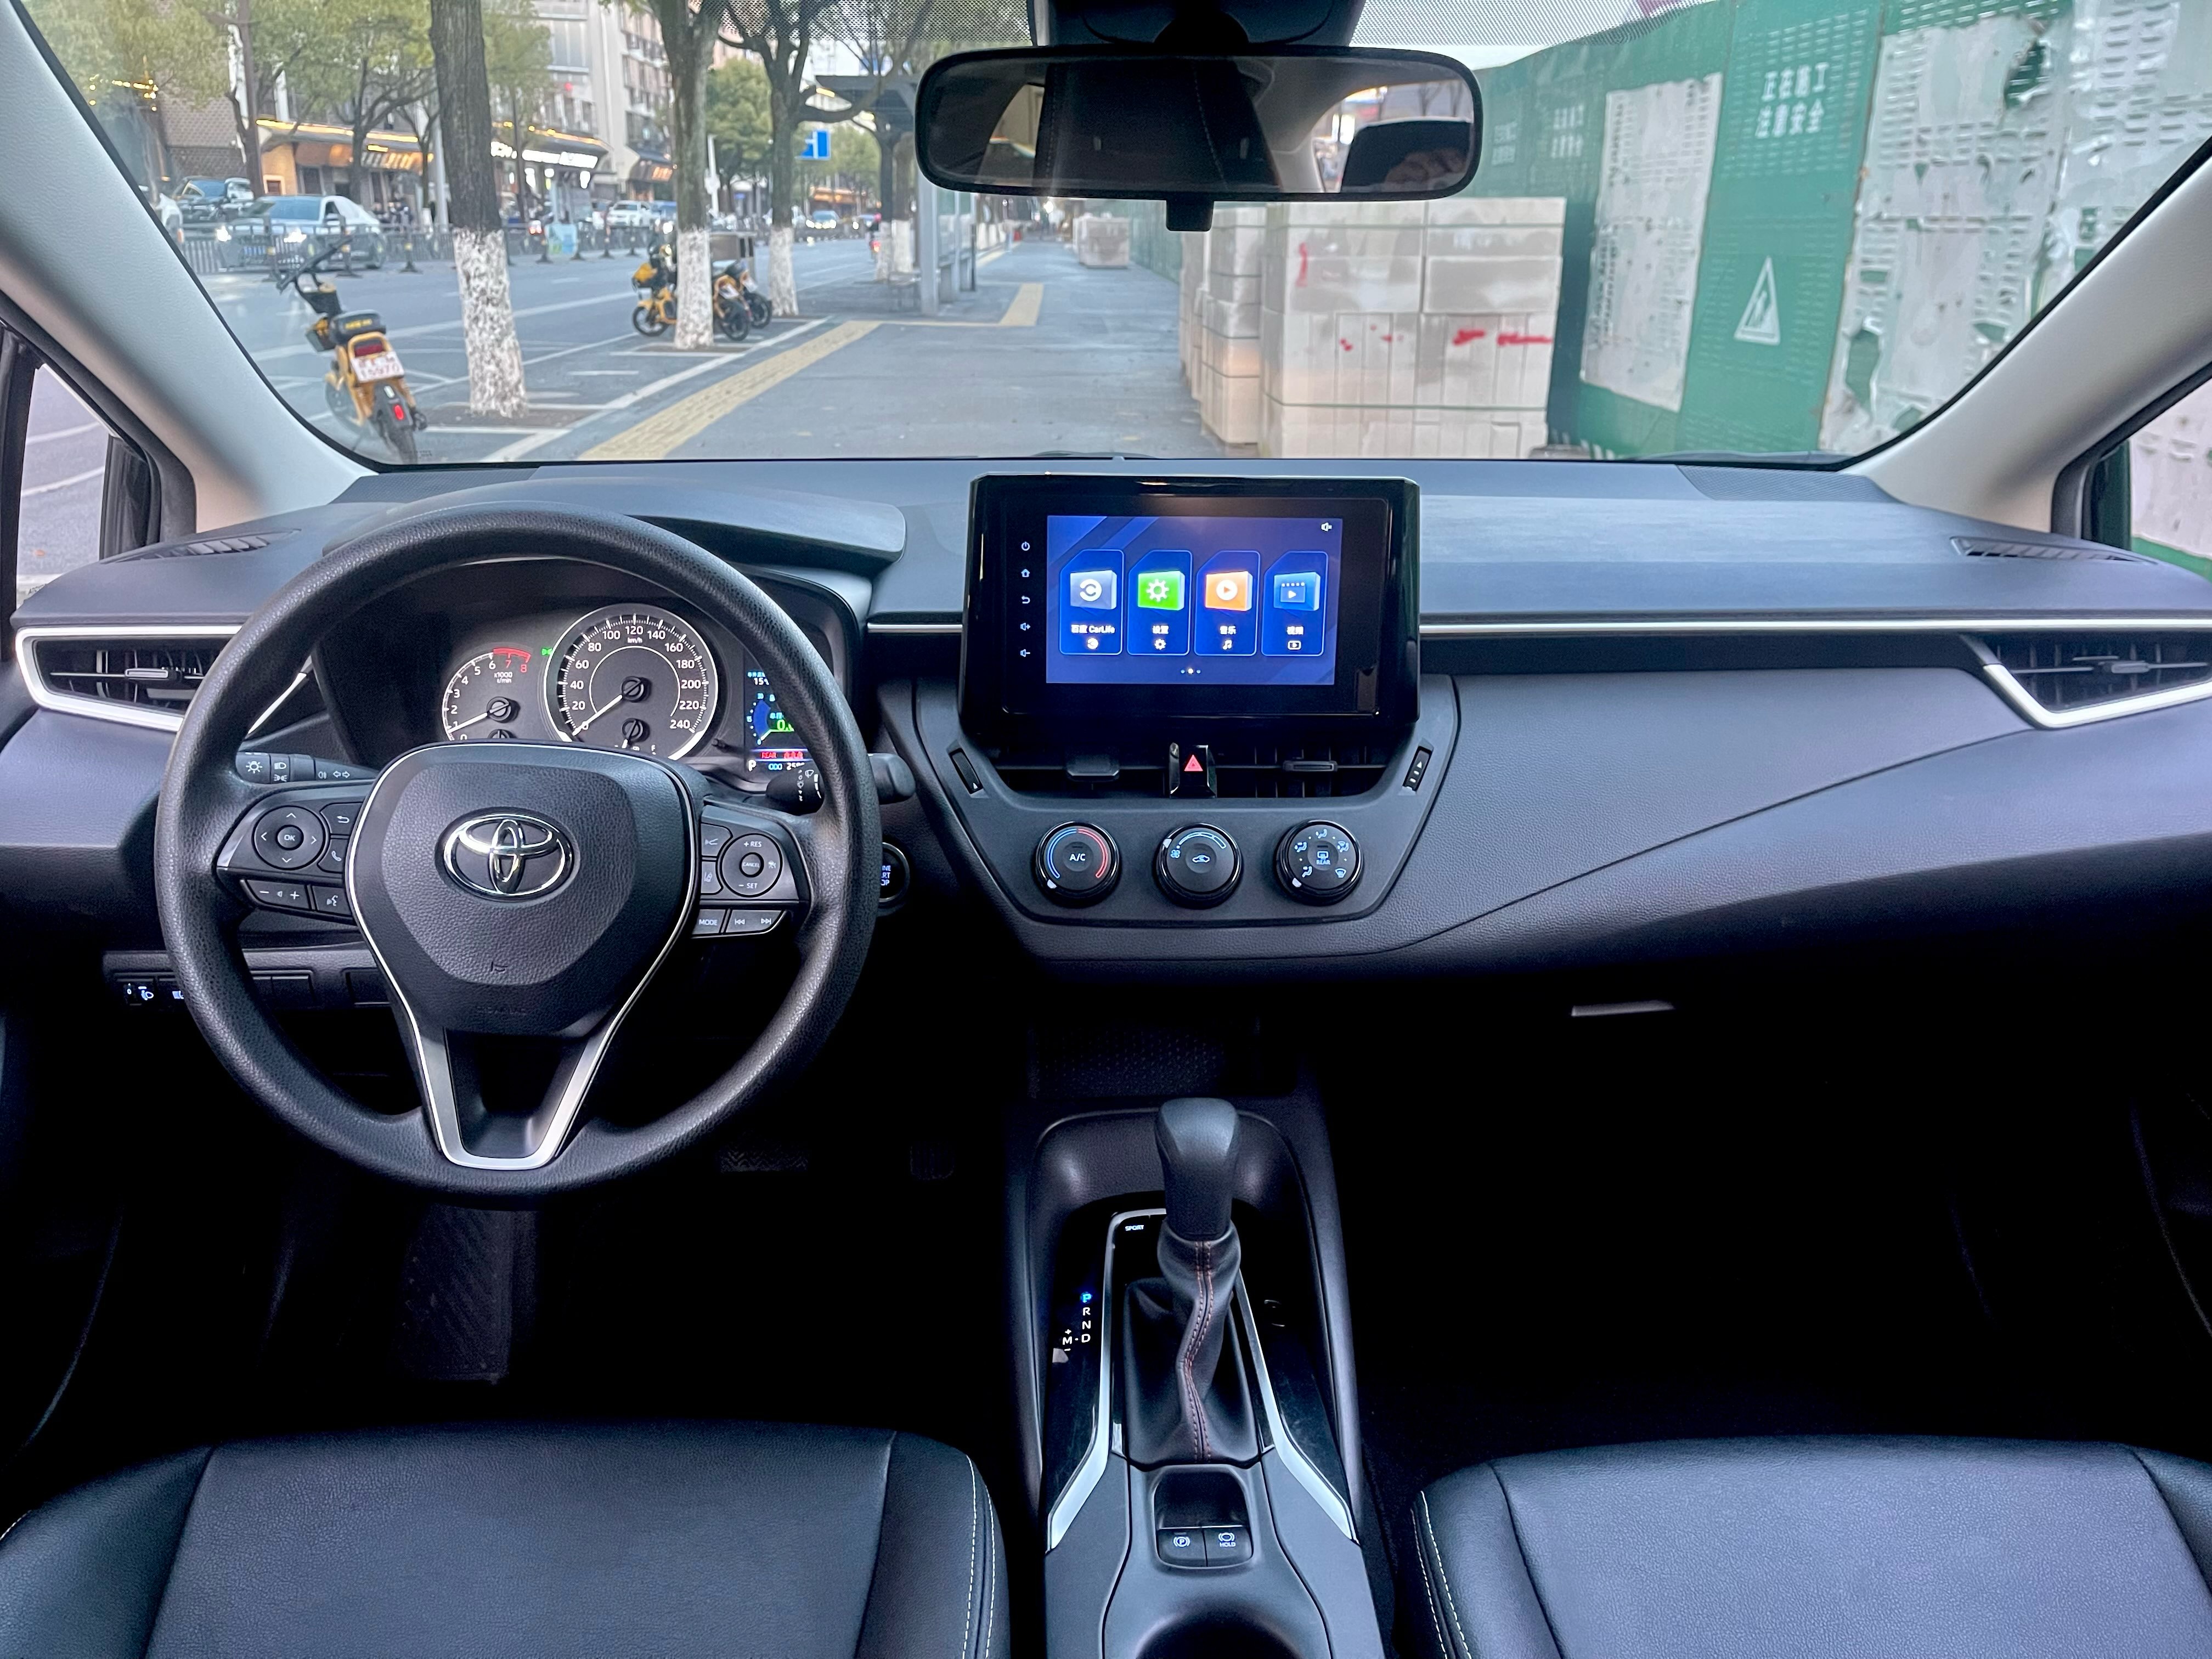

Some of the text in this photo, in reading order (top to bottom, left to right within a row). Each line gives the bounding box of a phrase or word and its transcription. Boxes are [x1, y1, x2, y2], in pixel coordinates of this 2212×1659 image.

[625, 626, 644, 635] 120
[1089, 625, 1115, 634] CarLife
[602, 631, 620, 640] 100
[647, 631, 665, 640] 140
[588, 642, 602, 652] 80
[665, 643, 683, 652] 160
[489, 661, 496, 670] 6
[505, 660, 511, 668] 7
[521, 664, 527, 673] 8
[575, 659, 590, 669] 60
[676, 659, 695, 669] 180
[474, 667, 481, 675] 5
[461, 675, 469, 685] 4
[681, 679, 701, 689] 200
[569, 680, 585, 690] 40
[454, 689, 460, 698] 3
[450, 705, 458, 714] 2
[572, 701, 585, 710] 20
[679, 701, 699, 710] 220
[670, 720, 690, 729] 240
[748, 759, 757, 771] P
[1069, 853, 1086, 861] A/C
[1082, 1293, 1092, 1303] P
[1082, 1307, 1091, 1316] R
[1082, 1320, 1091, 1330] N
[1062, 1334, 1091, 1345] M D
